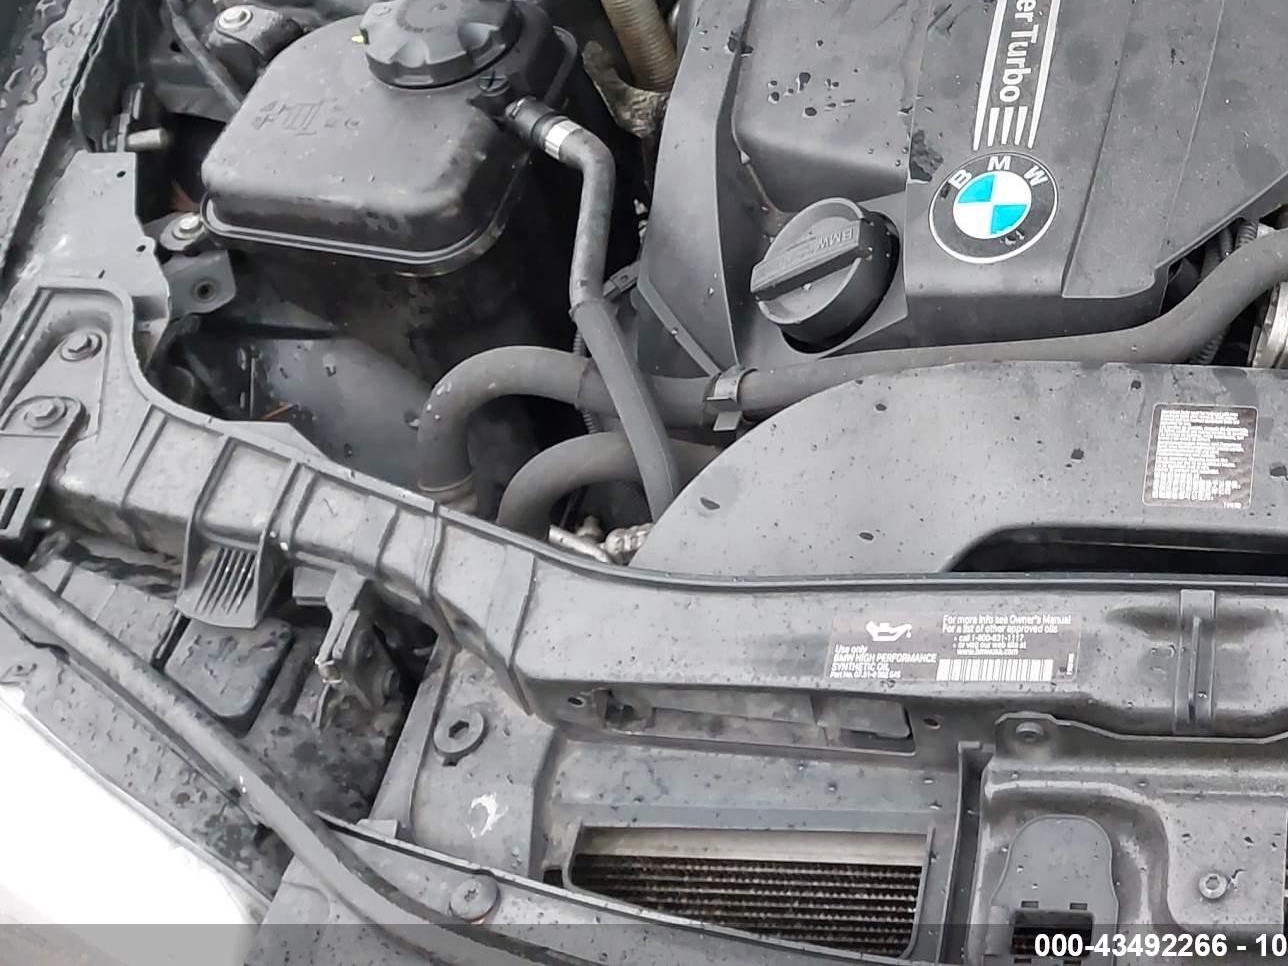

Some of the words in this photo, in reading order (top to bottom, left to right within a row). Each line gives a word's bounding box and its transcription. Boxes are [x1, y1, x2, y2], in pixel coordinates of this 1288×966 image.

[999, 24, 1038, 103] Turbo
[947, 154, 1050, 191] BMW
[815, 227, 855, 250] BMW
[943, 615, 957, 624] For
[957, 616, 977, 625] more
[995, 617, 1008, 625] see
[1009, 615, 1041, 625] Owner's
[1042, 615, 1072, 625] Manual
[942, 624, 956, 634] For
[1006, 625, 1043, 635] approved
[834, 644, 851, 654] Use
[851, 644, 868, 655] only
[833, 653, 855, 663] BMW
[855, 653, 876, 663] HIGH
[876, 653, 937, 664] PERFORMANCE
[831, 662, 877, 672] SYNTHETIC
[877, 663, 890, 672] OIL
